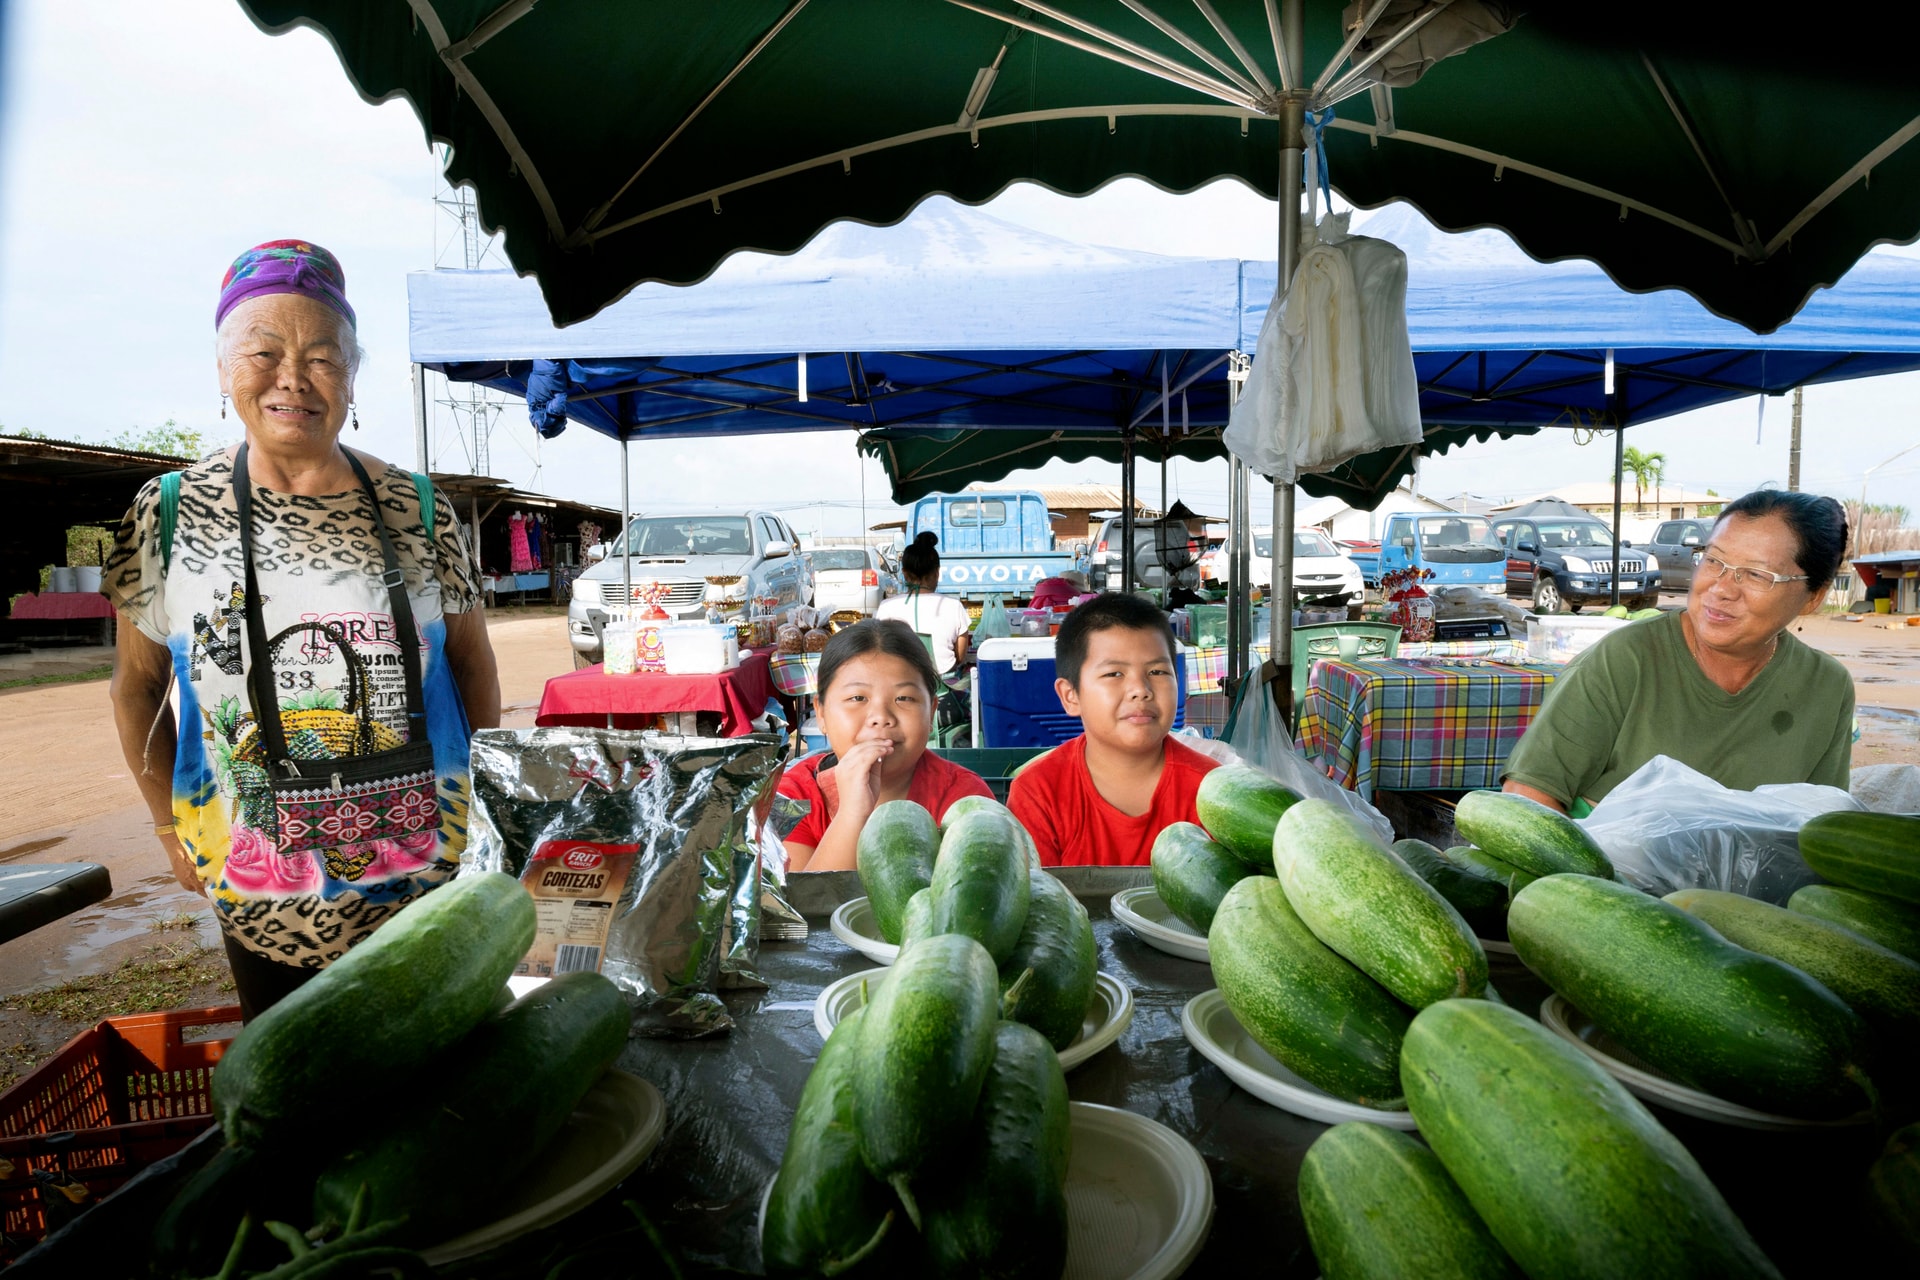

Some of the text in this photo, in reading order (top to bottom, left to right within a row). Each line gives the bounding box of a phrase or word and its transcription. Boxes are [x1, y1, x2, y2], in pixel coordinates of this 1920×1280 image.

[939, 565, 1047, 582] TOYOTA
[568, 851, 600, 863] FRIT
[542, 871, 605, 889] CORTEZAS
[536, 962, 552, 978] 1kg
